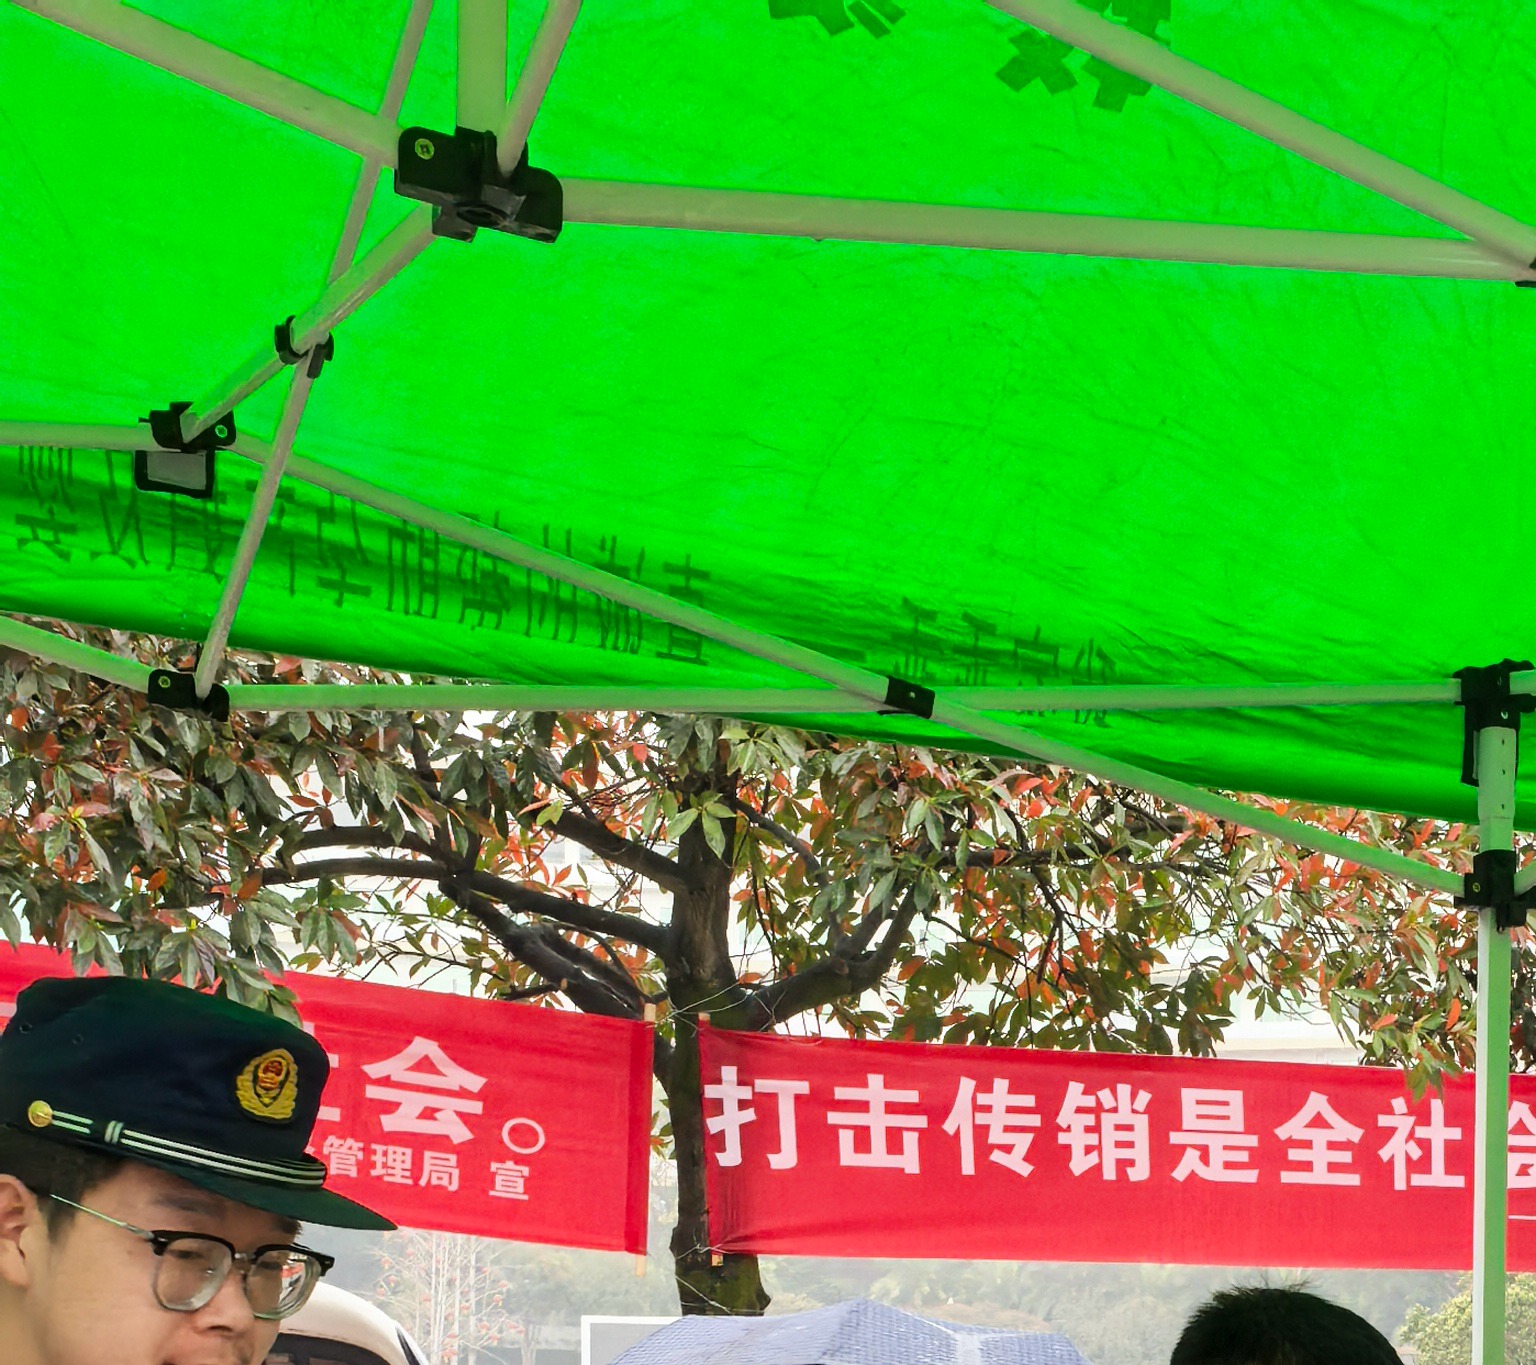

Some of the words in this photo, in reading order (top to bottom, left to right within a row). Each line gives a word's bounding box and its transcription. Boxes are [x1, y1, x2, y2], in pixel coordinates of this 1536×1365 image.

[302, 1021, 545, 1154] 会。
[304, 1135, 460, 1192] 管理局
[489, 1161, 530, 1200] 宣
